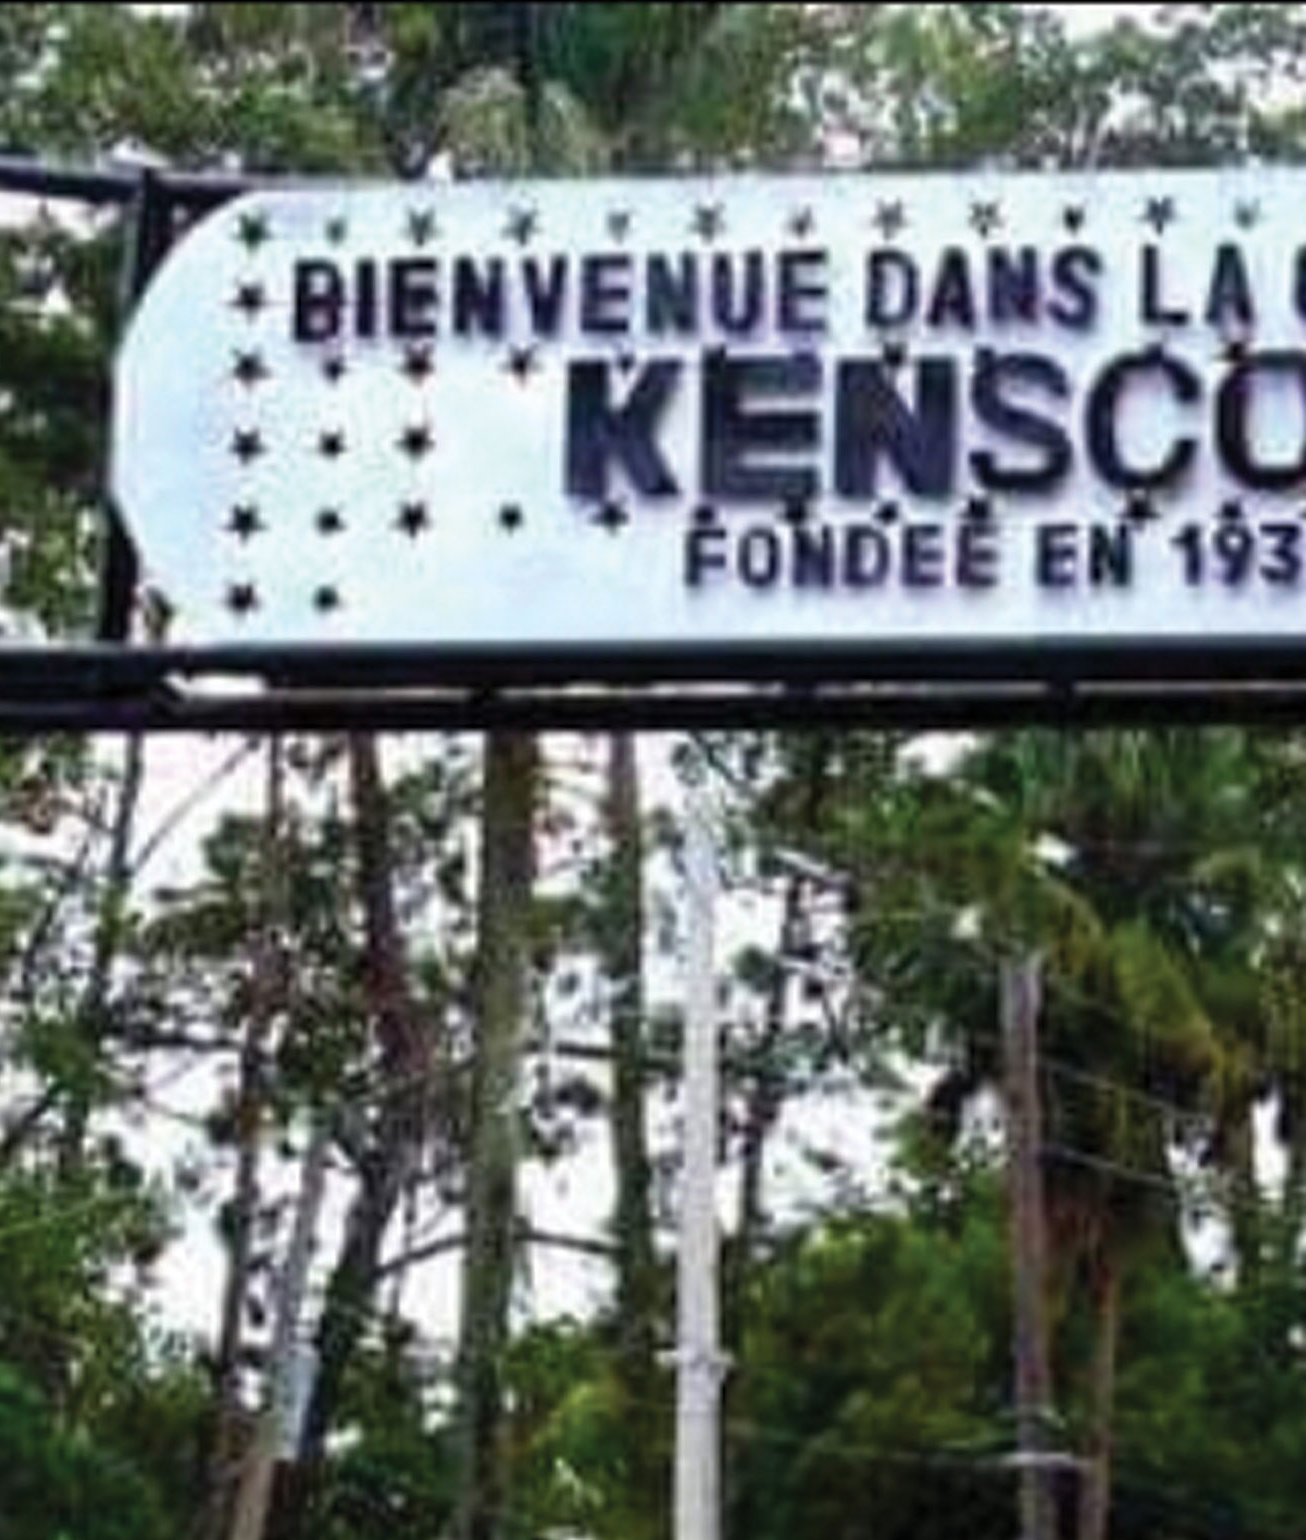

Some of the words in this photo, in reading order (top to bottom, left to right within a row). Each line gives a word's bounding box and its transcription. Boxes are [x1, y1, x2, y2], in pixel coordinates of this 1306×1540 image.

[293, 249, 829, 340] BIENVENUE
[864, 246, 1105, 331] DANS
[1140, 240, 1255, 328] LA
[1035, 522, 1133, 588] EN
